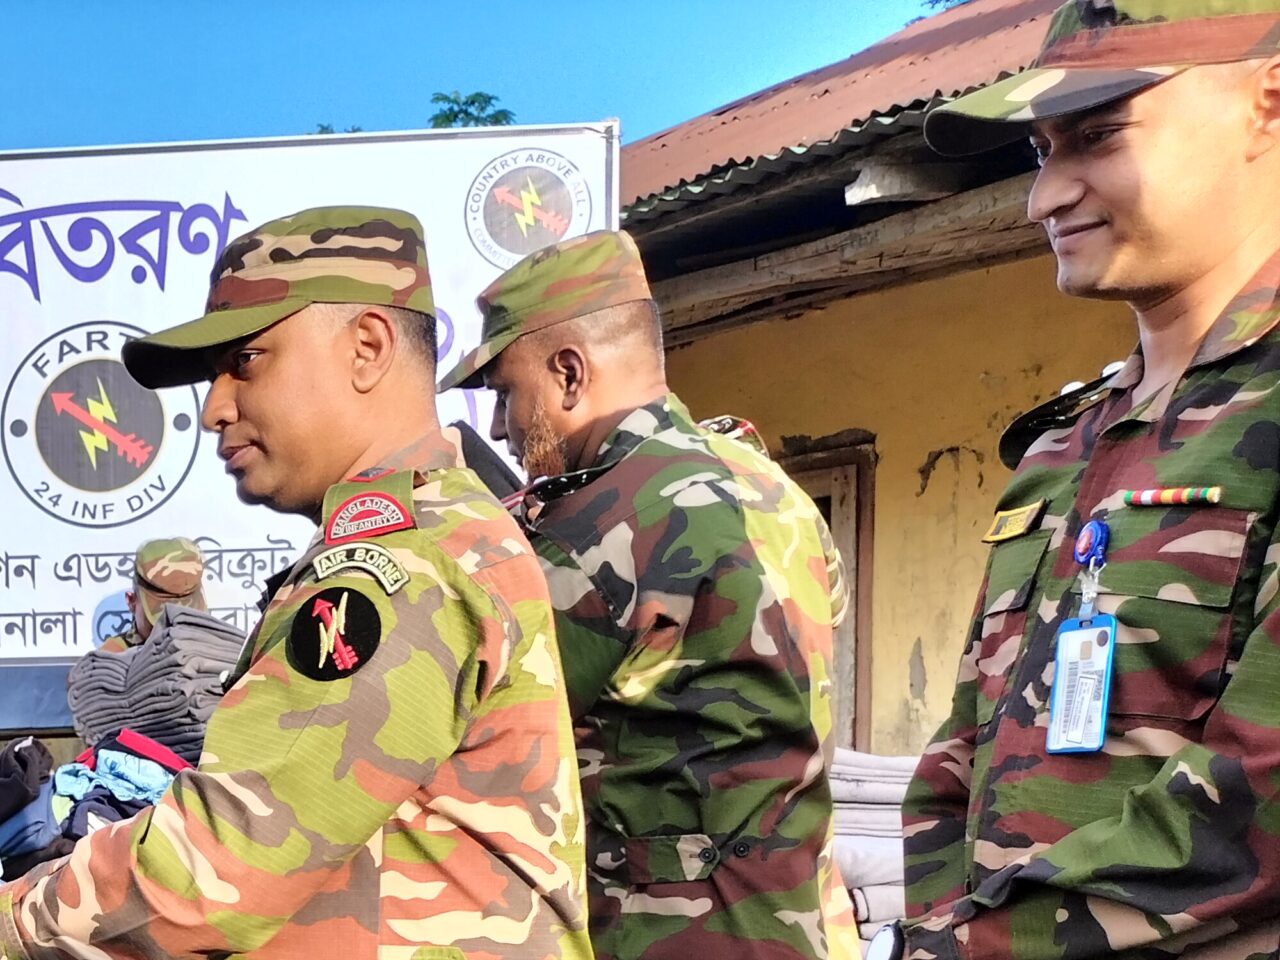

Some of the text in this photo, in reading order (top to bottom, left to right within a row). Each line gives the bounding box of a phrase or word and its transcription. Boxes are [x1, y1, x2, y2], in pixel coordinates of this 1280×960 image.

[469, 153, 586, 213] COUNTRY ABOVE ALL
[31, 330, 139, 379] FART
[33, 474, 167, 520] 24 INF DIV
[332, 499, 402, 536] BANGLADESH
[345, 515, 389, 533] INFANTRY
[320, 548, 404, 586] AIR BORNE
